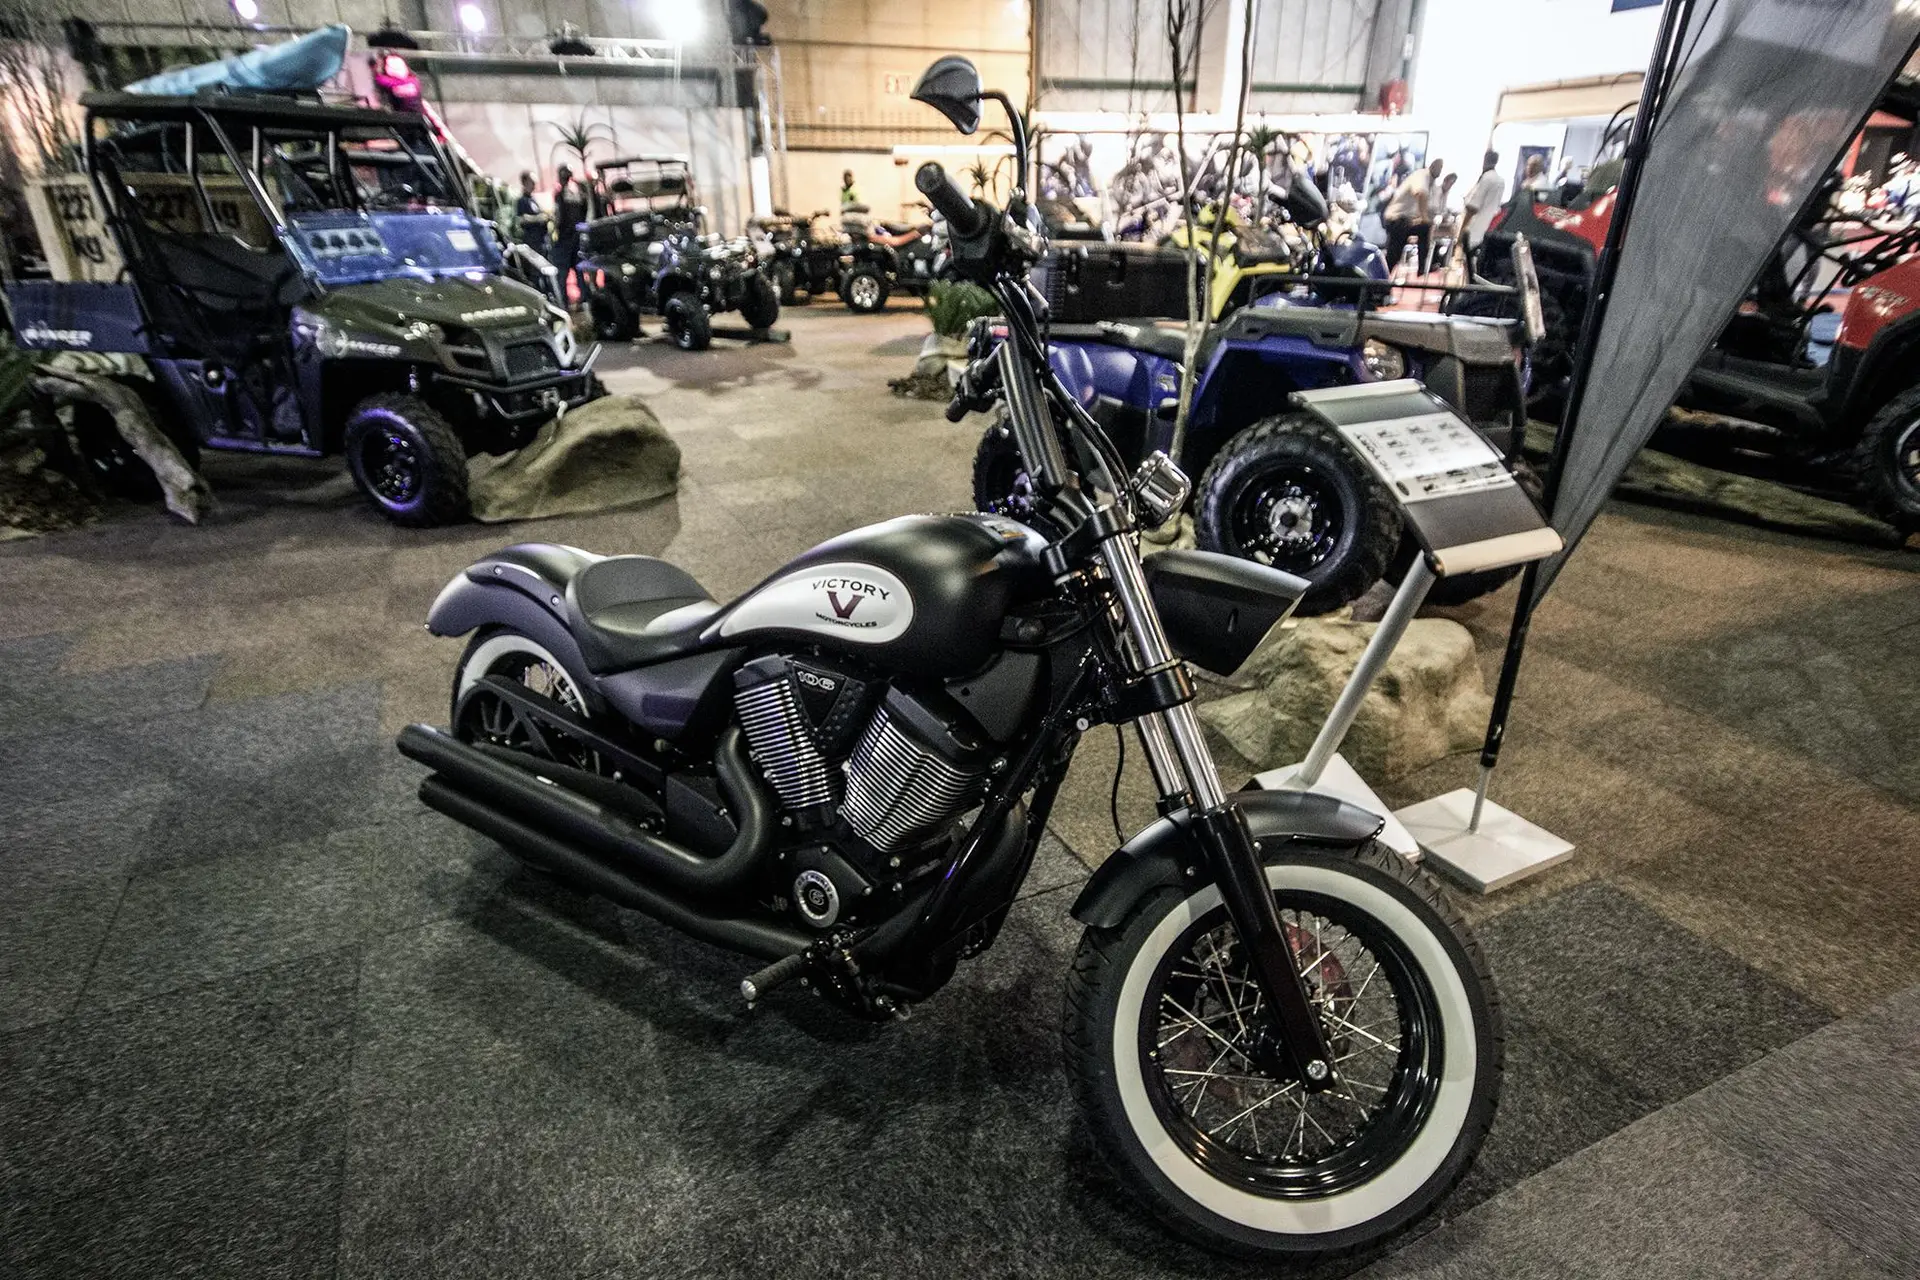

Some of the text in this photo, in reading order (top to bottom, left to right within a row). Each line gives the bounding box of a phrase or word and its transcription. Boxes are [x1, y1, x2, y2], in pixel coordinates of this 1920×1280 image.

[58, 193, 96, 220] 227
[68, 227, 105, 263] kg
[812, 578, 890, 600] VICTORY
[826, 590, 866, 620] V
[815, 611, 878, 628] MOTORCYCLES
[797, 670, 836, 691] 106
